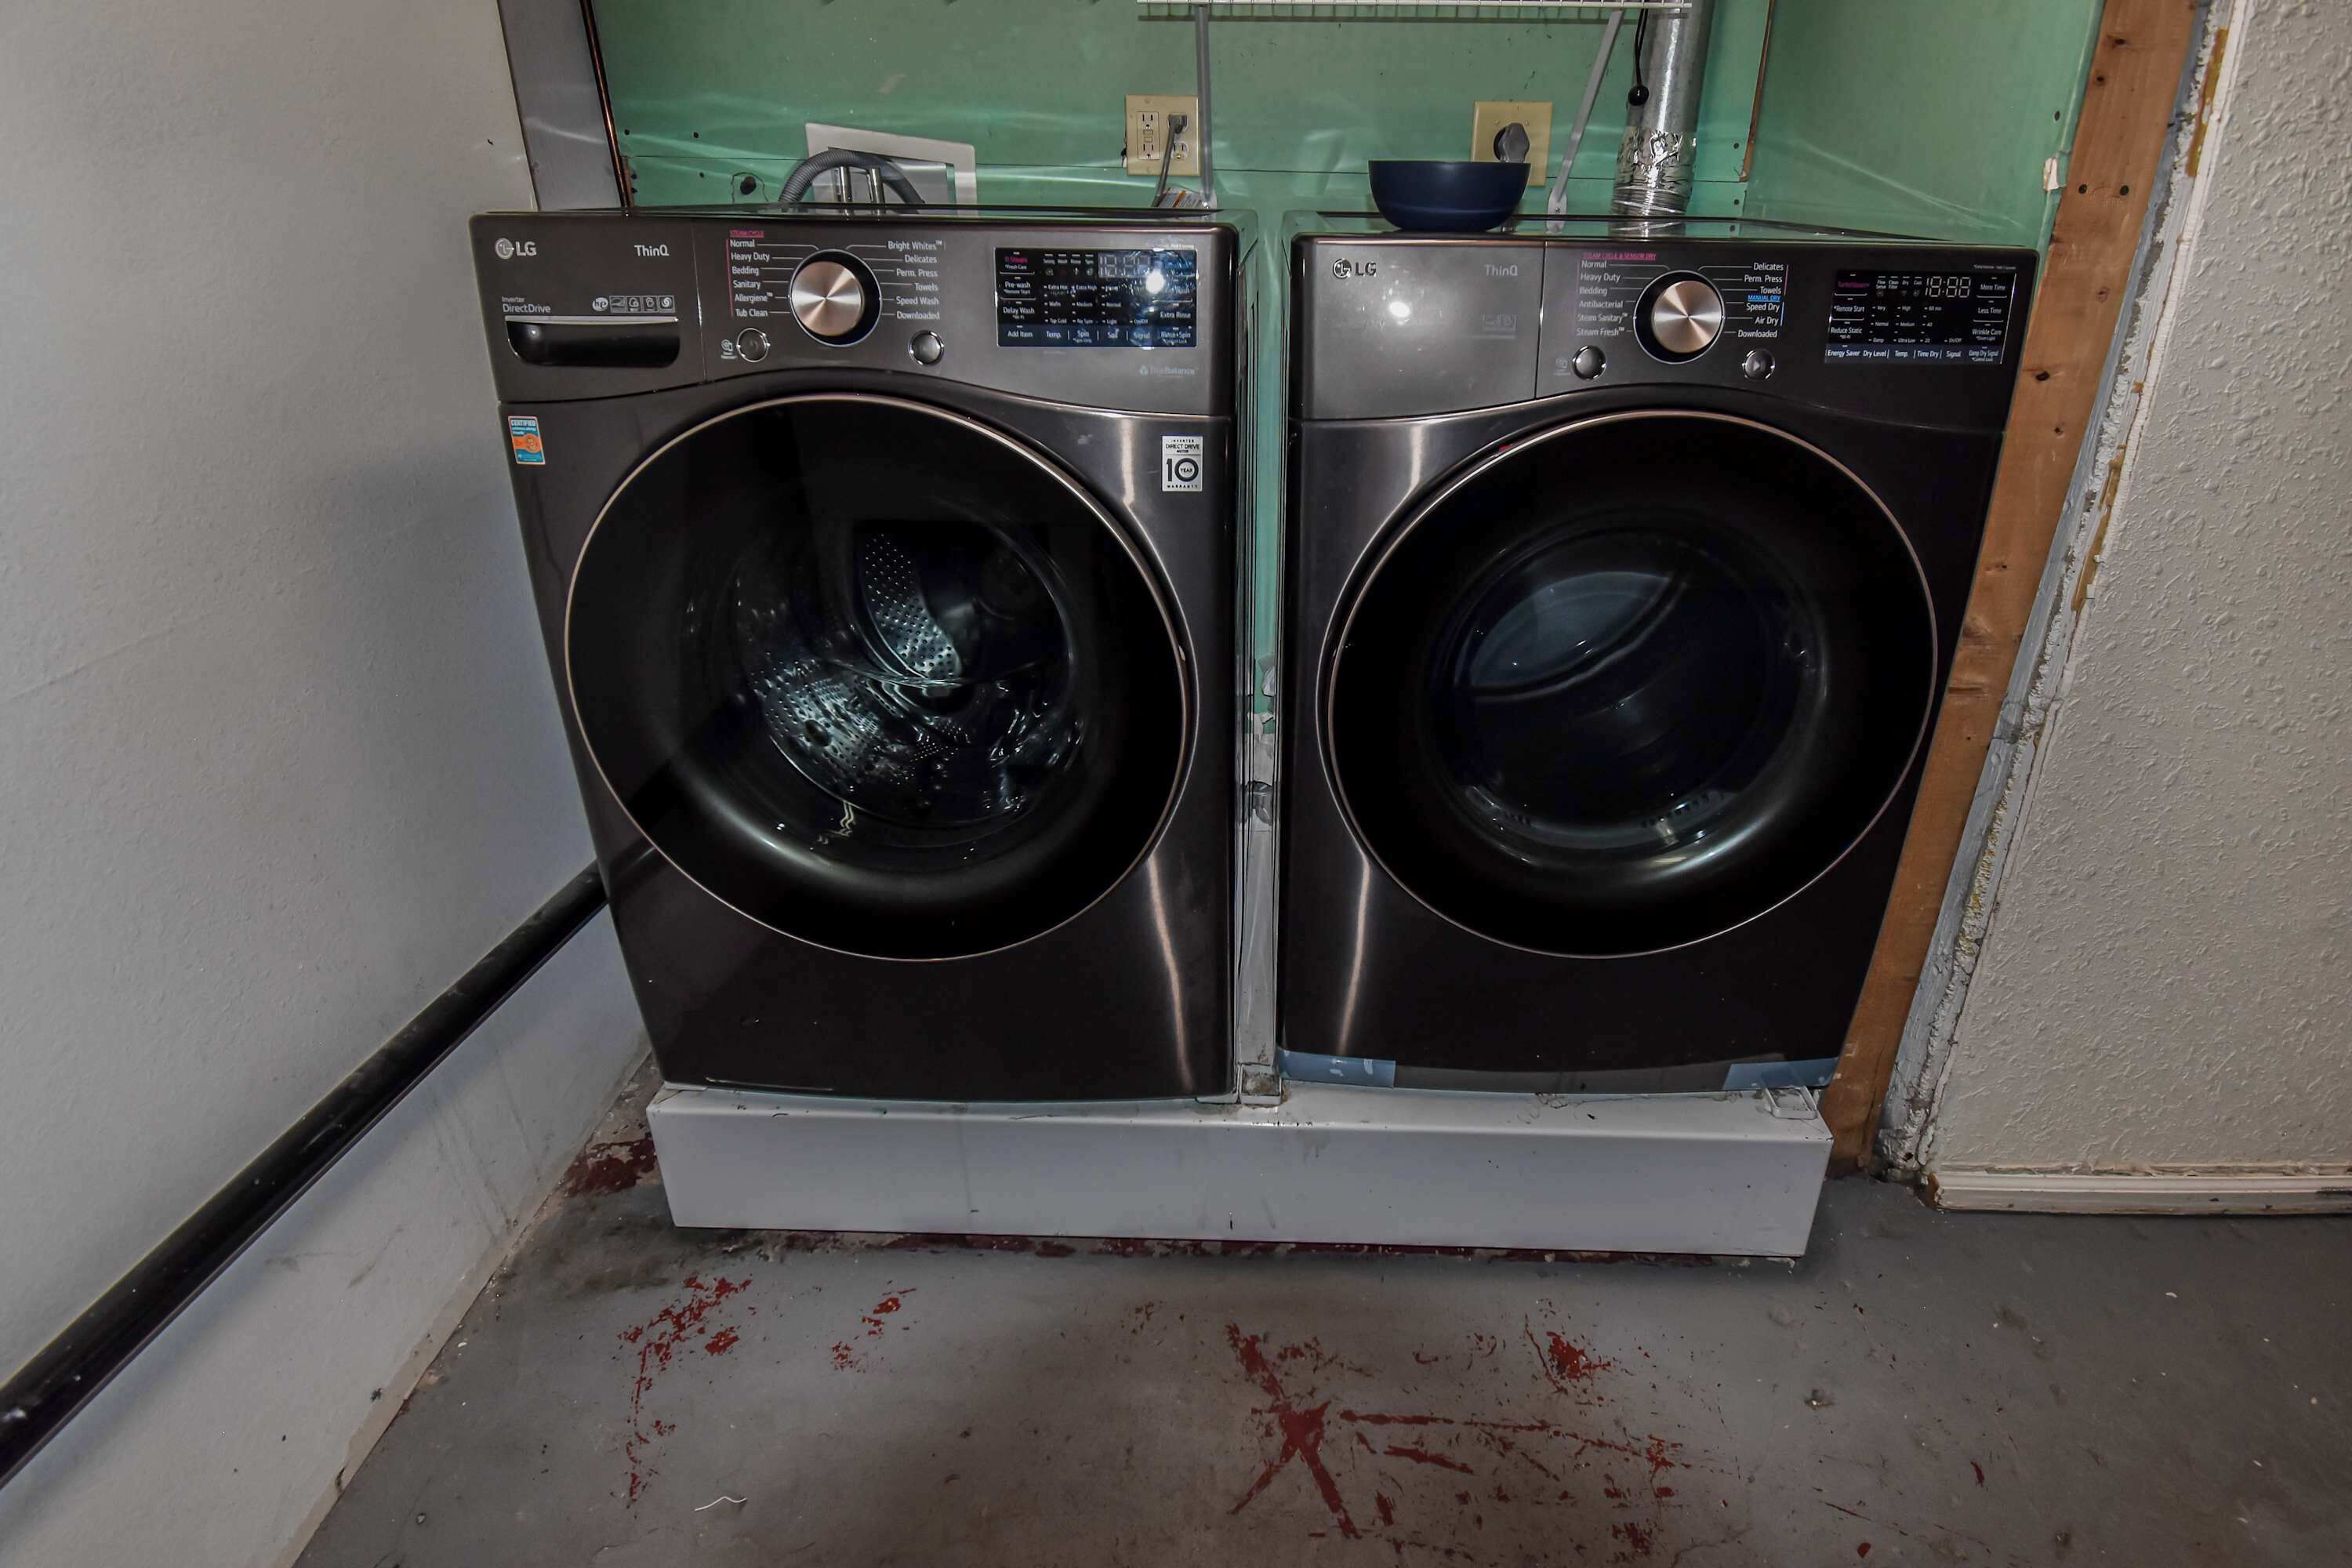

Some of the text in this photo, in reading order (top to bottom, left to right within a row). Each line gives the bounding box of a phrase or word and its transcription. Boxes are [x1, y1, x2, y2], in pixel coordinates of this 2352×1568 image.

[515, 241, 537, 256] LG
[730, 239, 756, 248] Normal
[887, 241, 910, 251] Bright
[633, 244, 670, 257] ThinQ
[731, 252, 770, 263] Heavy Duty
[905, 254, 938, 263] Delicates
[731, 266, 759, 276] Bedding
[896, 268, 938, 277] Perm. Press
[1355, 262, 1377, 276] LG
[1483, 264, 1518, 276] ThinQ
[1580, 273, 1621, 283] Heavy Duty
[732, 280, 760, 290] Sanitary
[1579, 286, 1607, 296] Bedding
[895, 296, 939, 306] Speed Wash
[503, 303, 551, 313] DirectDrive
[1003, 307, 1018, 315] Delay
[1746, 303, 1780, 313] Speed Dry
[896, 310, 940, 320] Downloaded
[1766, 317, 1779, 326] Dry
[1166, 458, 1199, 482] 10
